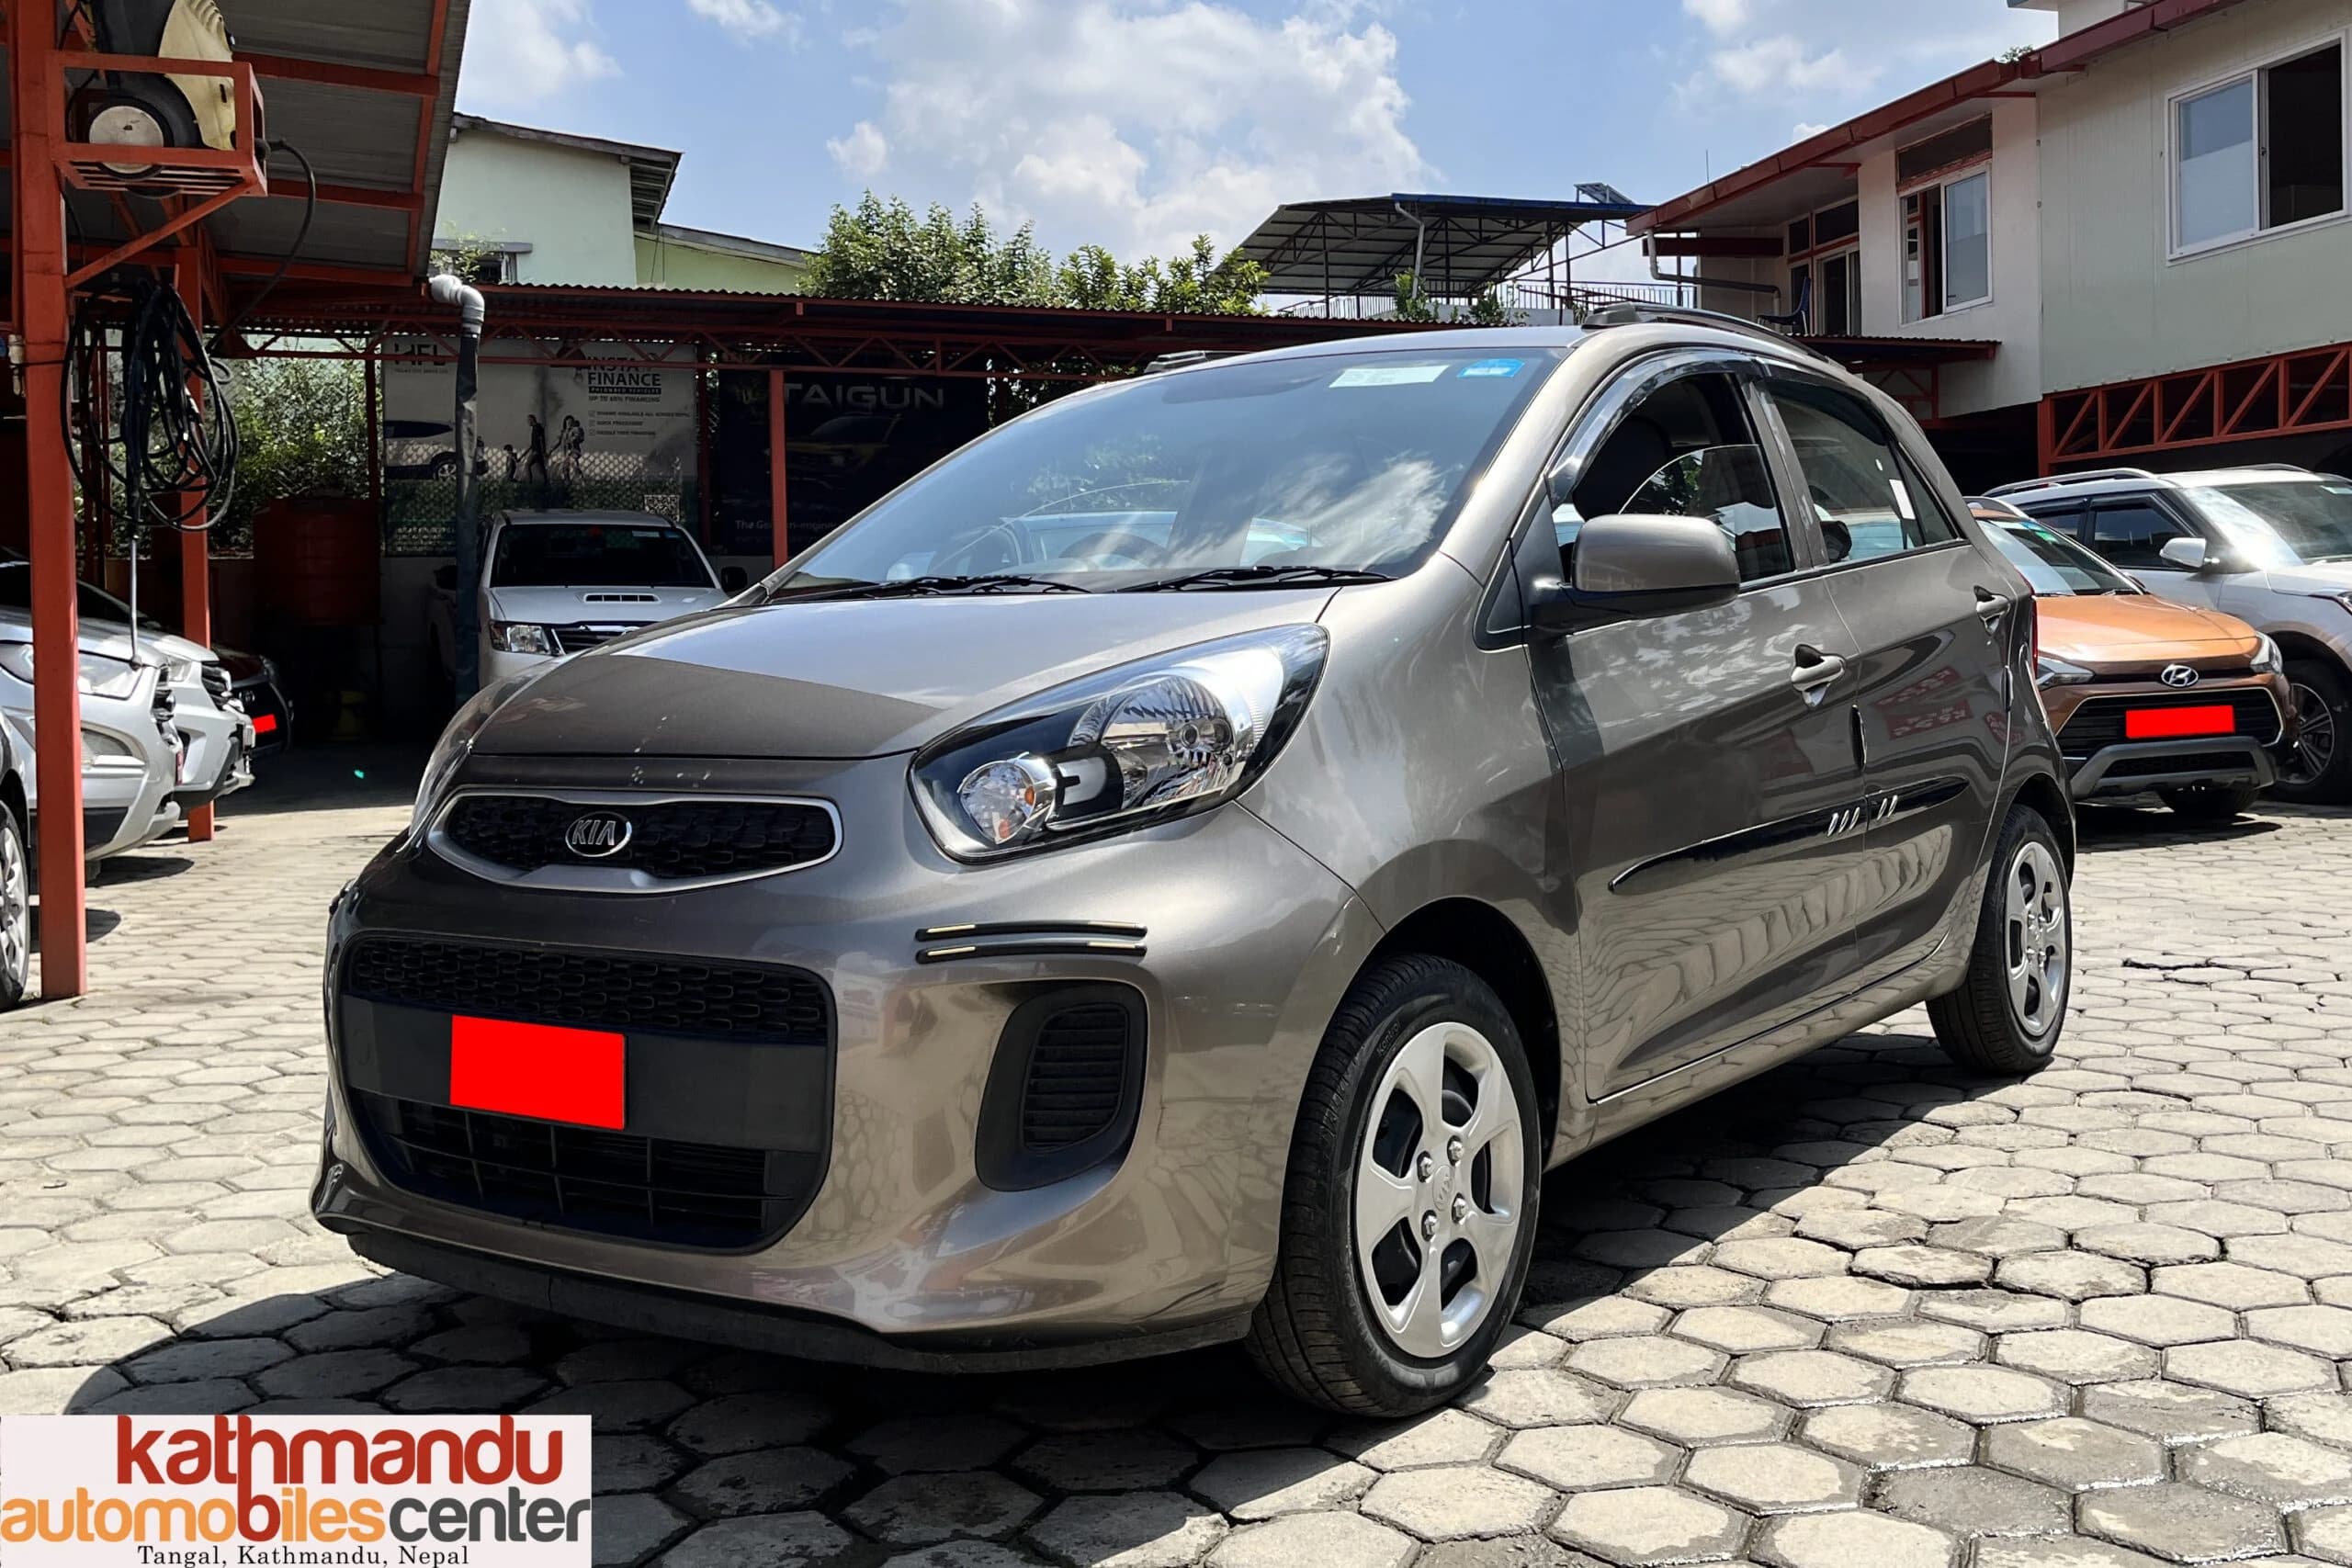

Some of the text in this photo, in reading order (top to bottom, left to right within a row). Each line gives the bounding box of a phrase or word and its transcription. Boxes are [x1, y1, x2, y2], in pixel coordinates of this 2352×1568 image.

[588, 356, 639, 372] INSTA
[588, 372, 662, 387] FINANCE
[784, 383, 944, 409] TAIGUN
[572, 819, 616, 846] KIA
